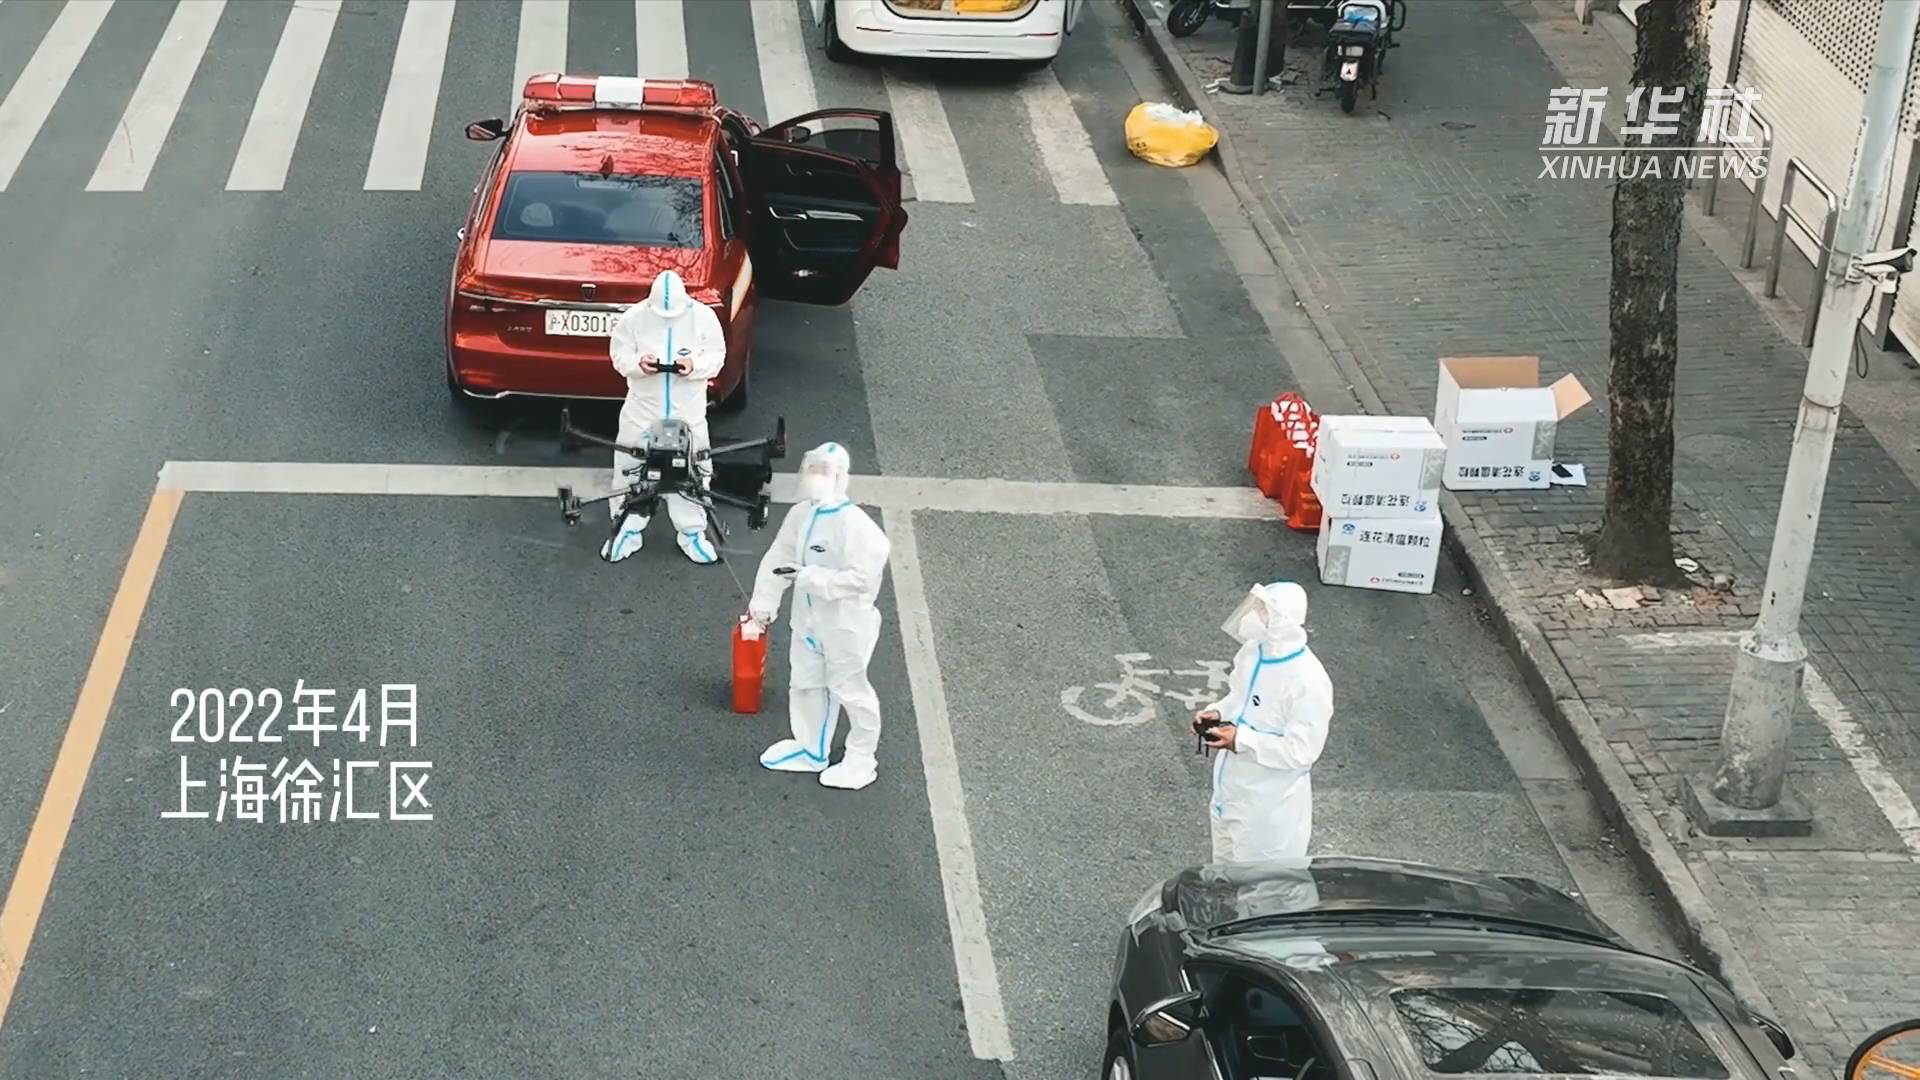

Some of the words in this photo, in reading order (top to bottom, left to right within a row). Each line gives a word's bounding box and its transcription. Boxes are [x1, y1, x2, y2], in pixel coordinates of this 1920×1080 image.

[1359, 529, 1431, 549] 连花清瘟颗粒
